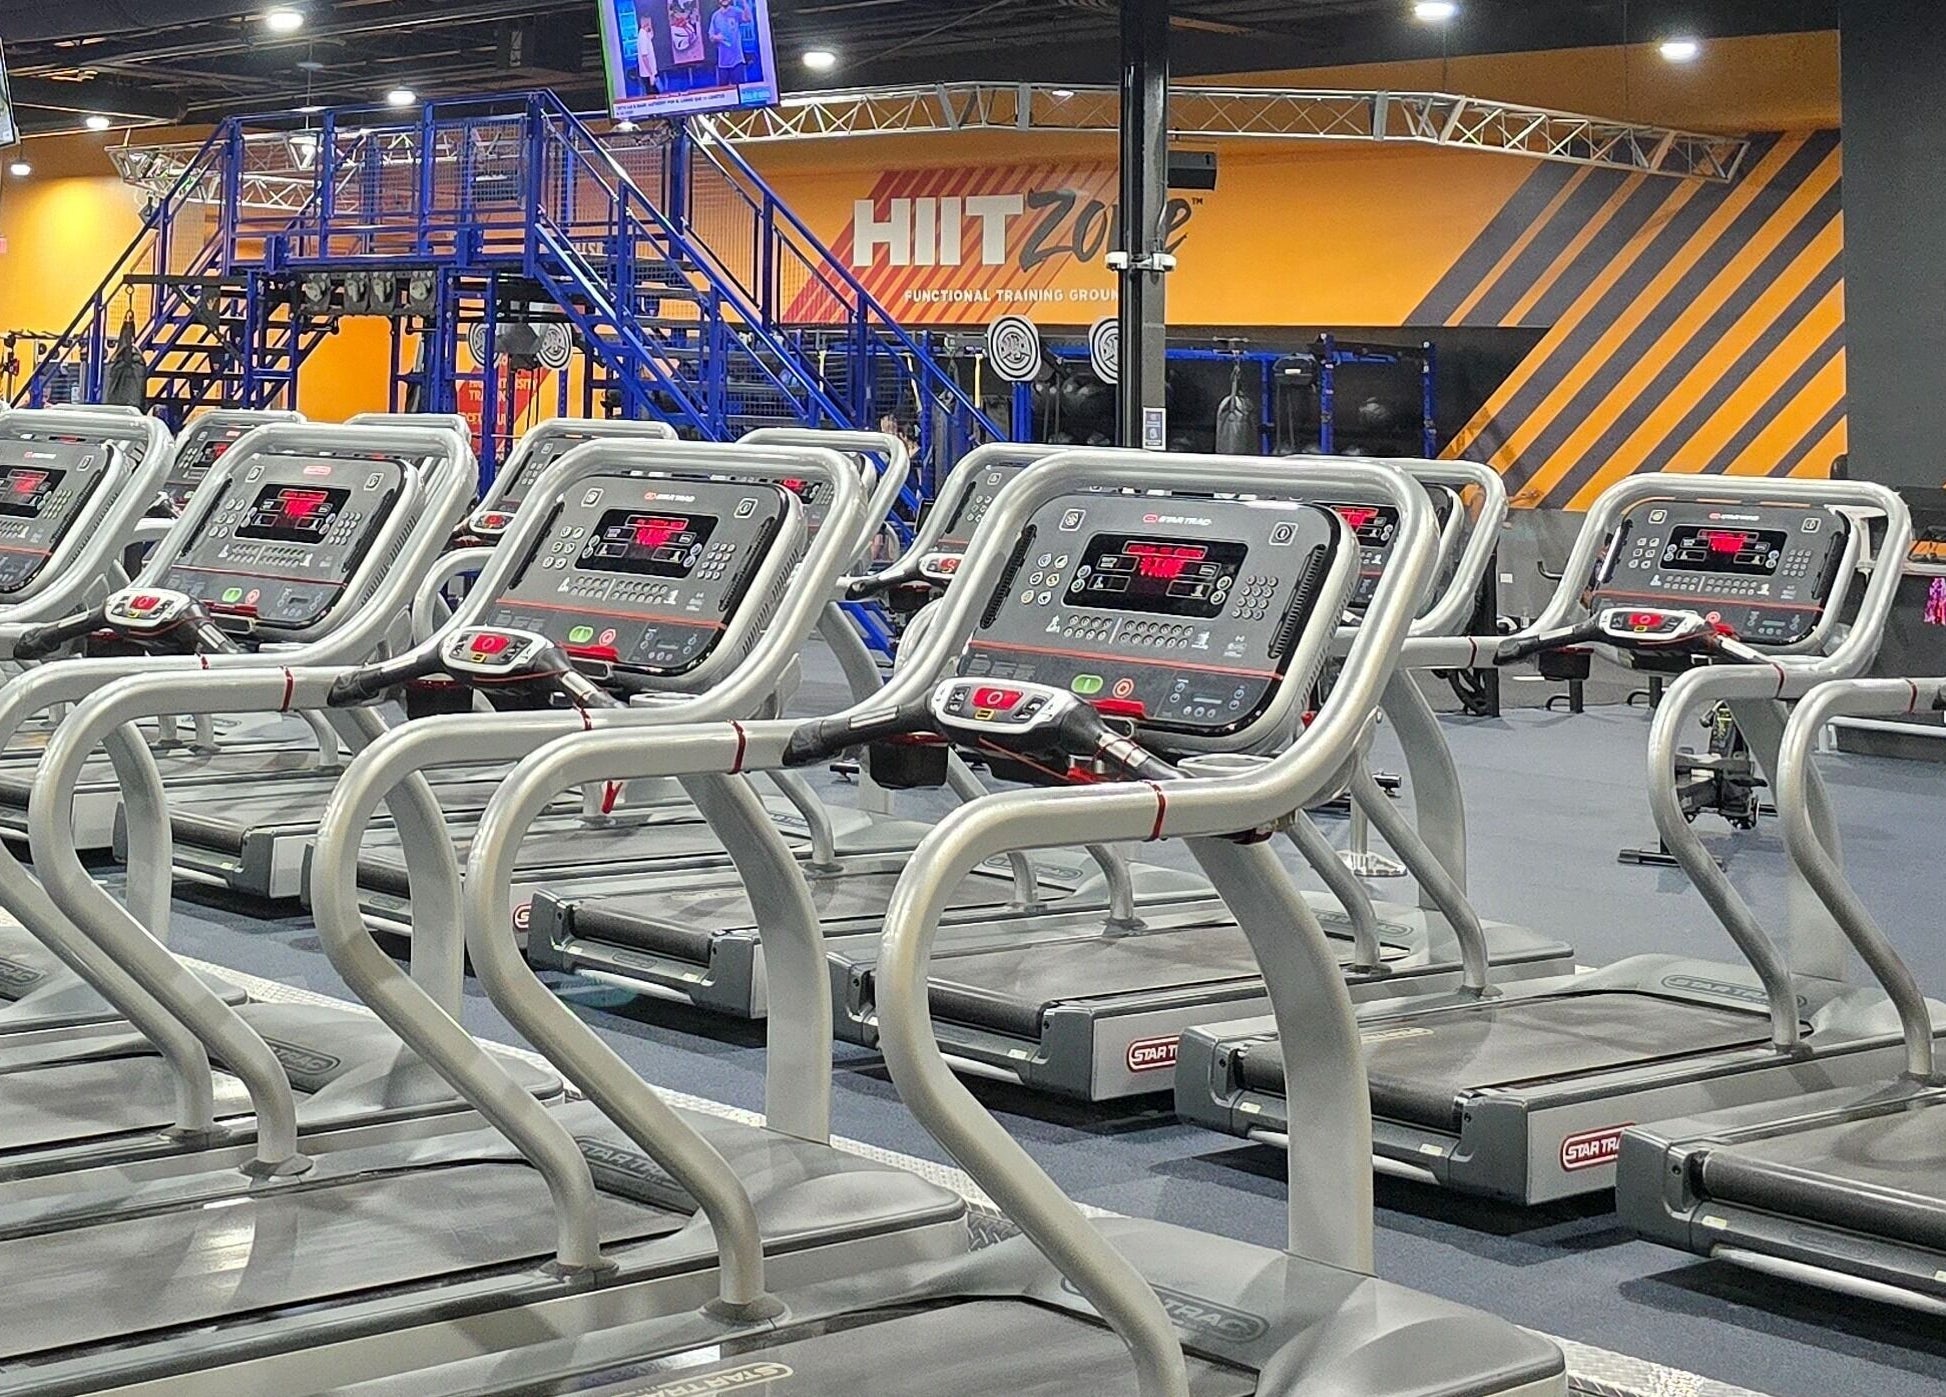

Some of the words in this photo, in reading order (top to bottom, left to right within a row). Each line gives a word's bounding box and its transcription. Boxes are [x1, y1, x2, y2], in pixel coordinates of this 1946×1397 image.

[853, 194, 1024, 267] HIIT
[1019, 188, 1192, 272] Zoe
[904, 288, 992, 302] FUNCTIONAL
[996, 288, 1064, 302] TRAINING
[1069, 288, 1119, 301] GROUN
[1131, 1046, 1167, 1061] STAR
[1565, 1141, 1600, 1160] STAR
[703, 1366, 780, 1389] STAR
